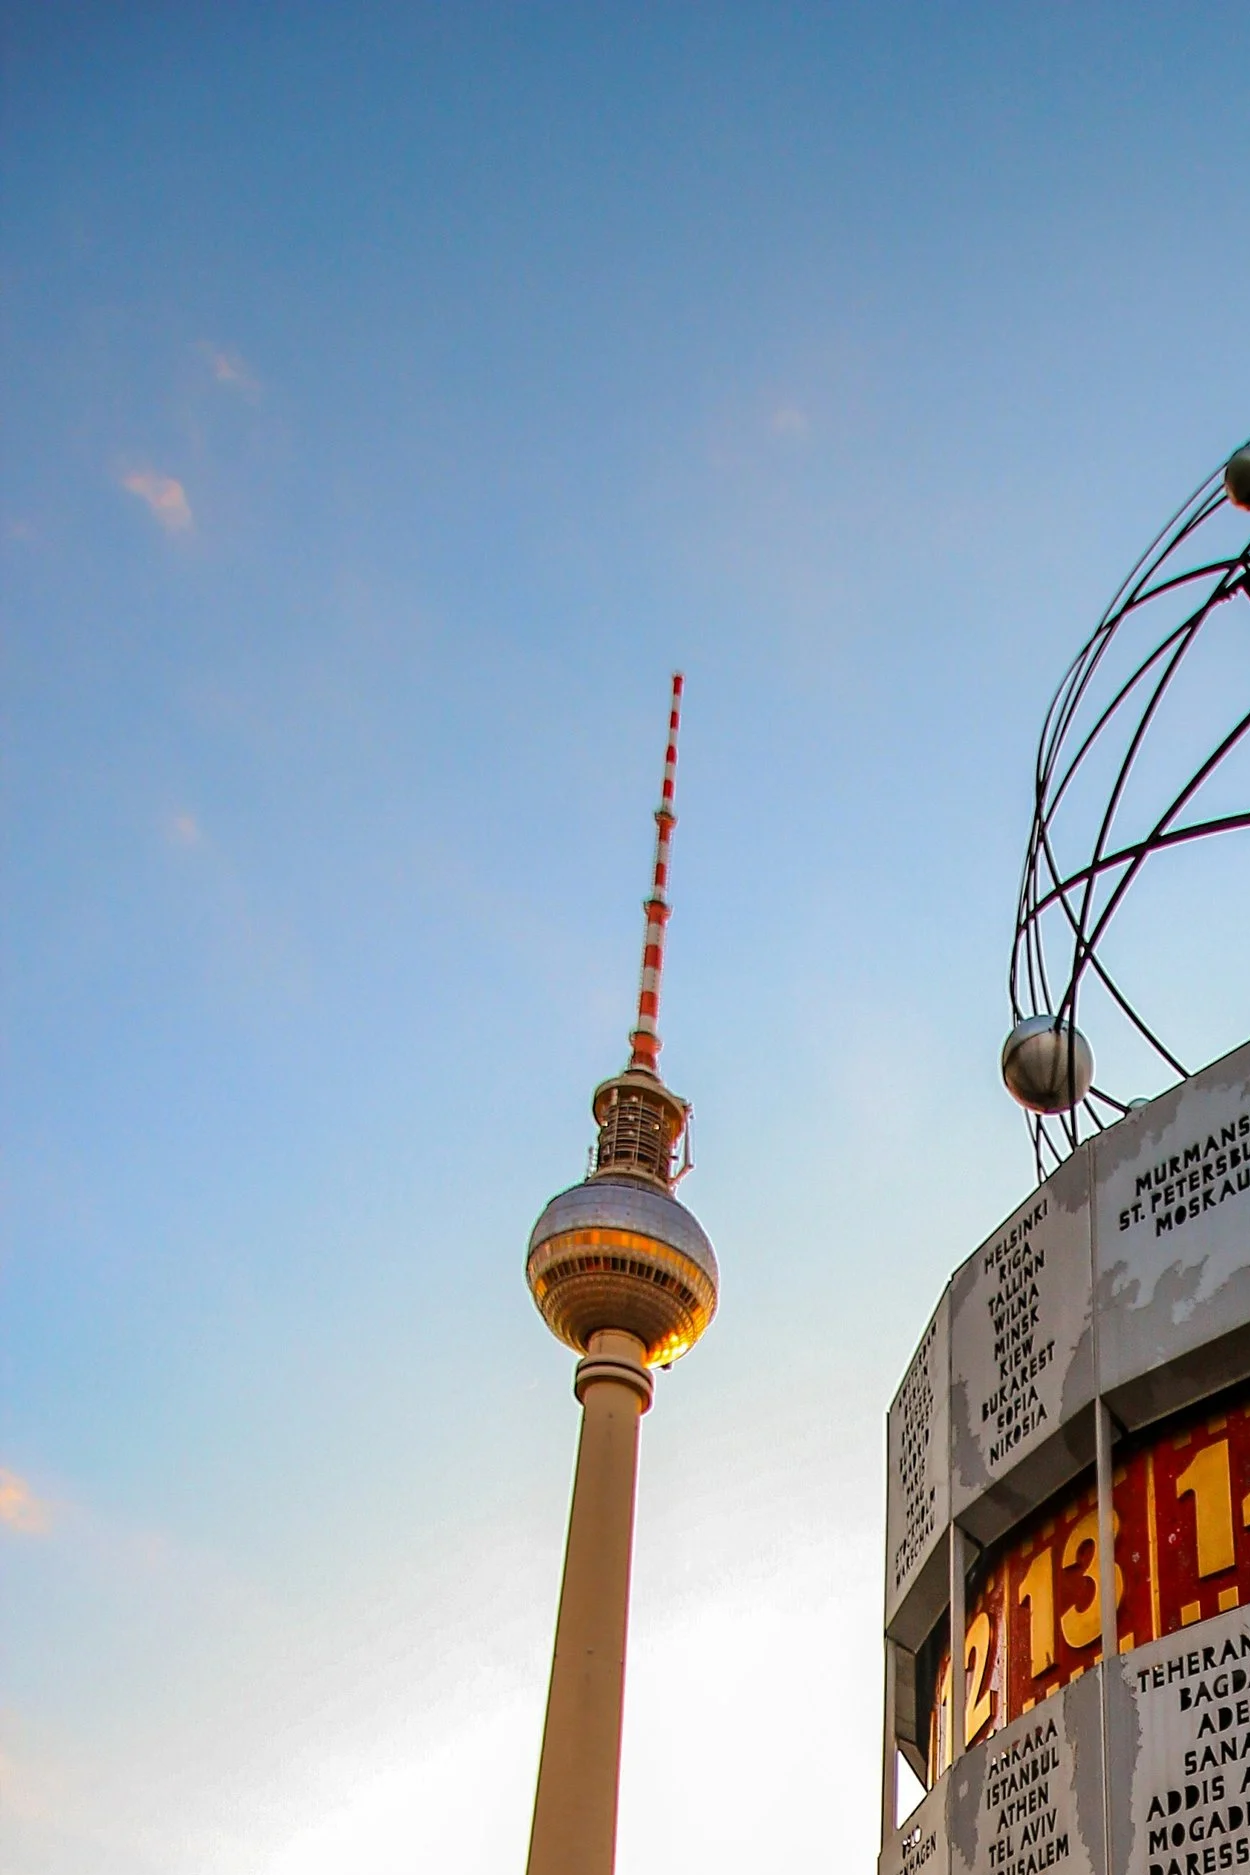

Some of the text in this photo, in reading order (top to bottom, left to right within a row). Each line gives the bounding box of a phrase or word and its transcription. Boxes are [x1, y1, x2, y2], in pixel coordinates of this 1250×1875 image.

[1119, 1203, 1146, 1231] ST.
[1155, 1168, 1250, 1237] MOSKAU
[984, 1198, 1048, 1275] HELSINKI
[998, 1241, 1032, 1284] RIGA
[987, 1249, 1045, 1316] TALLINN
[992, 1283, 1040, 1335] WILNA
[994, 1304, 1040, 1361] MINSK
[999, 1334, 1034, 1381] KIEW
[981, 1340, 1055, 1423] BUKAREST
[997, 1385, 1039, 1434] SOFIA
[989, 1403, 1048, 1466] NIKOSIA
[1018, 1507, 1124, 1679] 13
[986, 1747, 1060, 1811] ISTANBUL
[987, 1718, 1058, 1781] ANKARA
[997, 1782, 1049, 1834] ATHEN
[1146, 1775, 1225, 1823] ADDIS
[989, 1808, 1058, 1869] TEL AVIV
